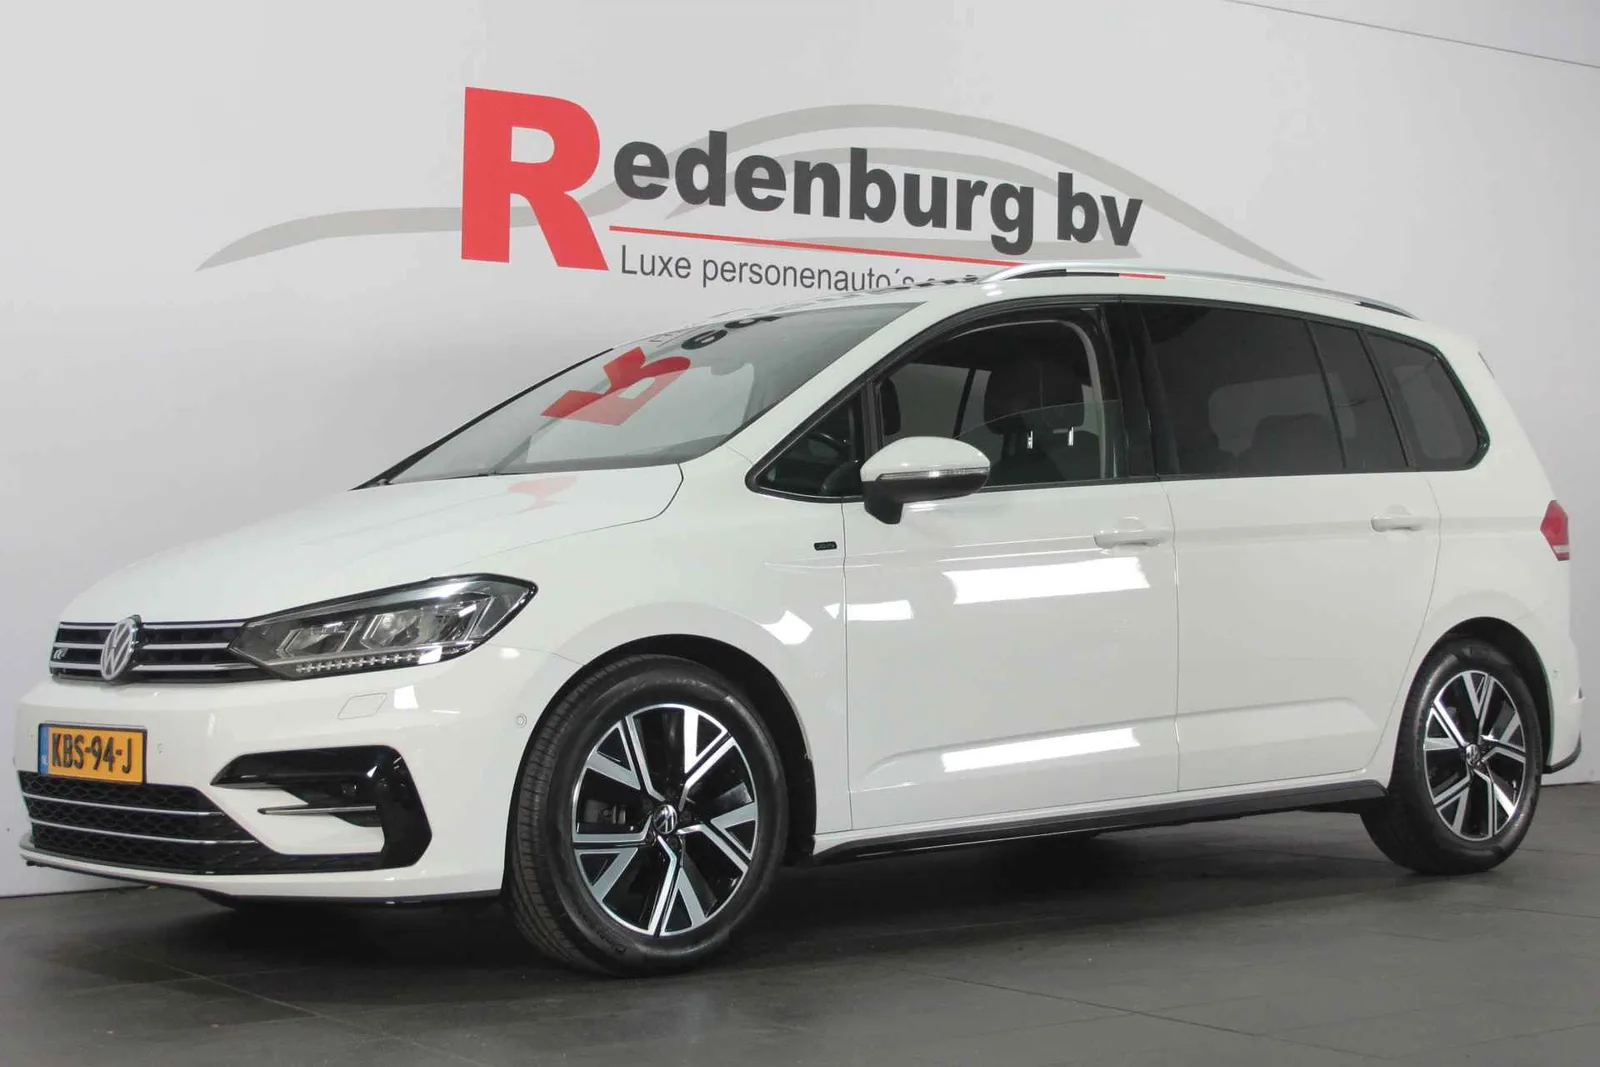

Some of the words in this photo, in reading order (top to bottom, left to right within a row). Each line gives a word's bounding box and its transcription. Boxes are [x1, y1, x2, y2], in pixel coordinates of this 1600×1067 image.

[462, 87, 1035, 271] Redenburg
[1057, 171, 1143, 247] bv
[621, 245, 692, 279] Luxe
[52, 733, 132, 774] KBS-94-J
